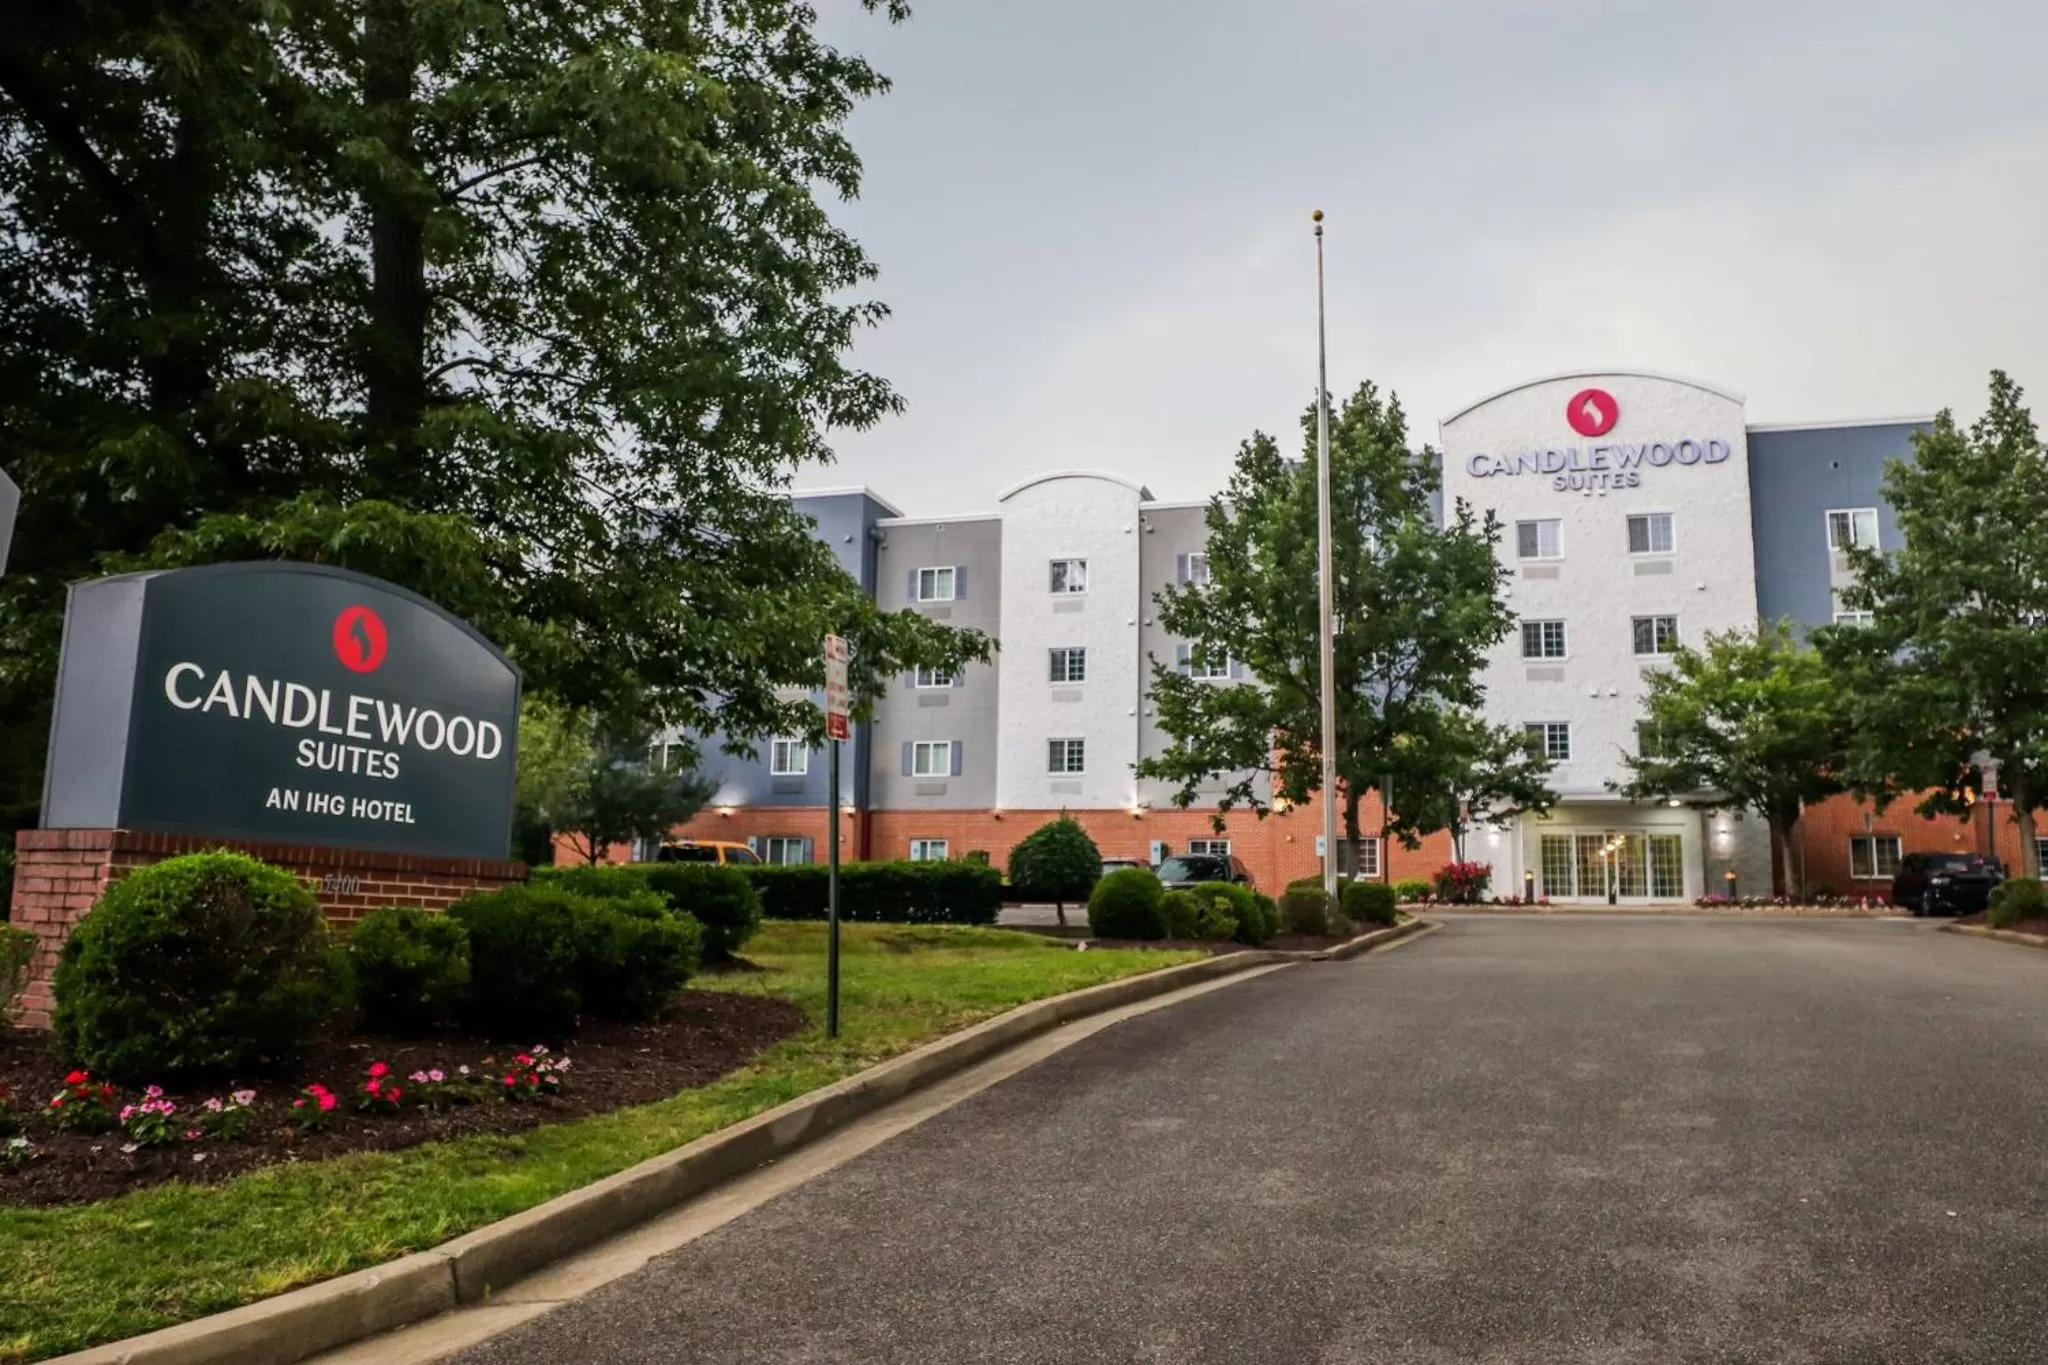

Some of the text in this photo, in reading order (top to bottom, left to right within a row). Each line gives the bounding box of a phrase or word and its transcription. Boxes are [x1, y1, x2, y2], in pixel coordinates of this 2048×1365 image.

[1467, 440, 1730, 477] CANDLEWOOD
[1553, 472, 1640, 491] SUITES
[164, 662, 502, 760] CANDLEWOOD
[296, 738, 400, 779] SUITES
[265, 787, 415, 824] AN IHG HOTEL
